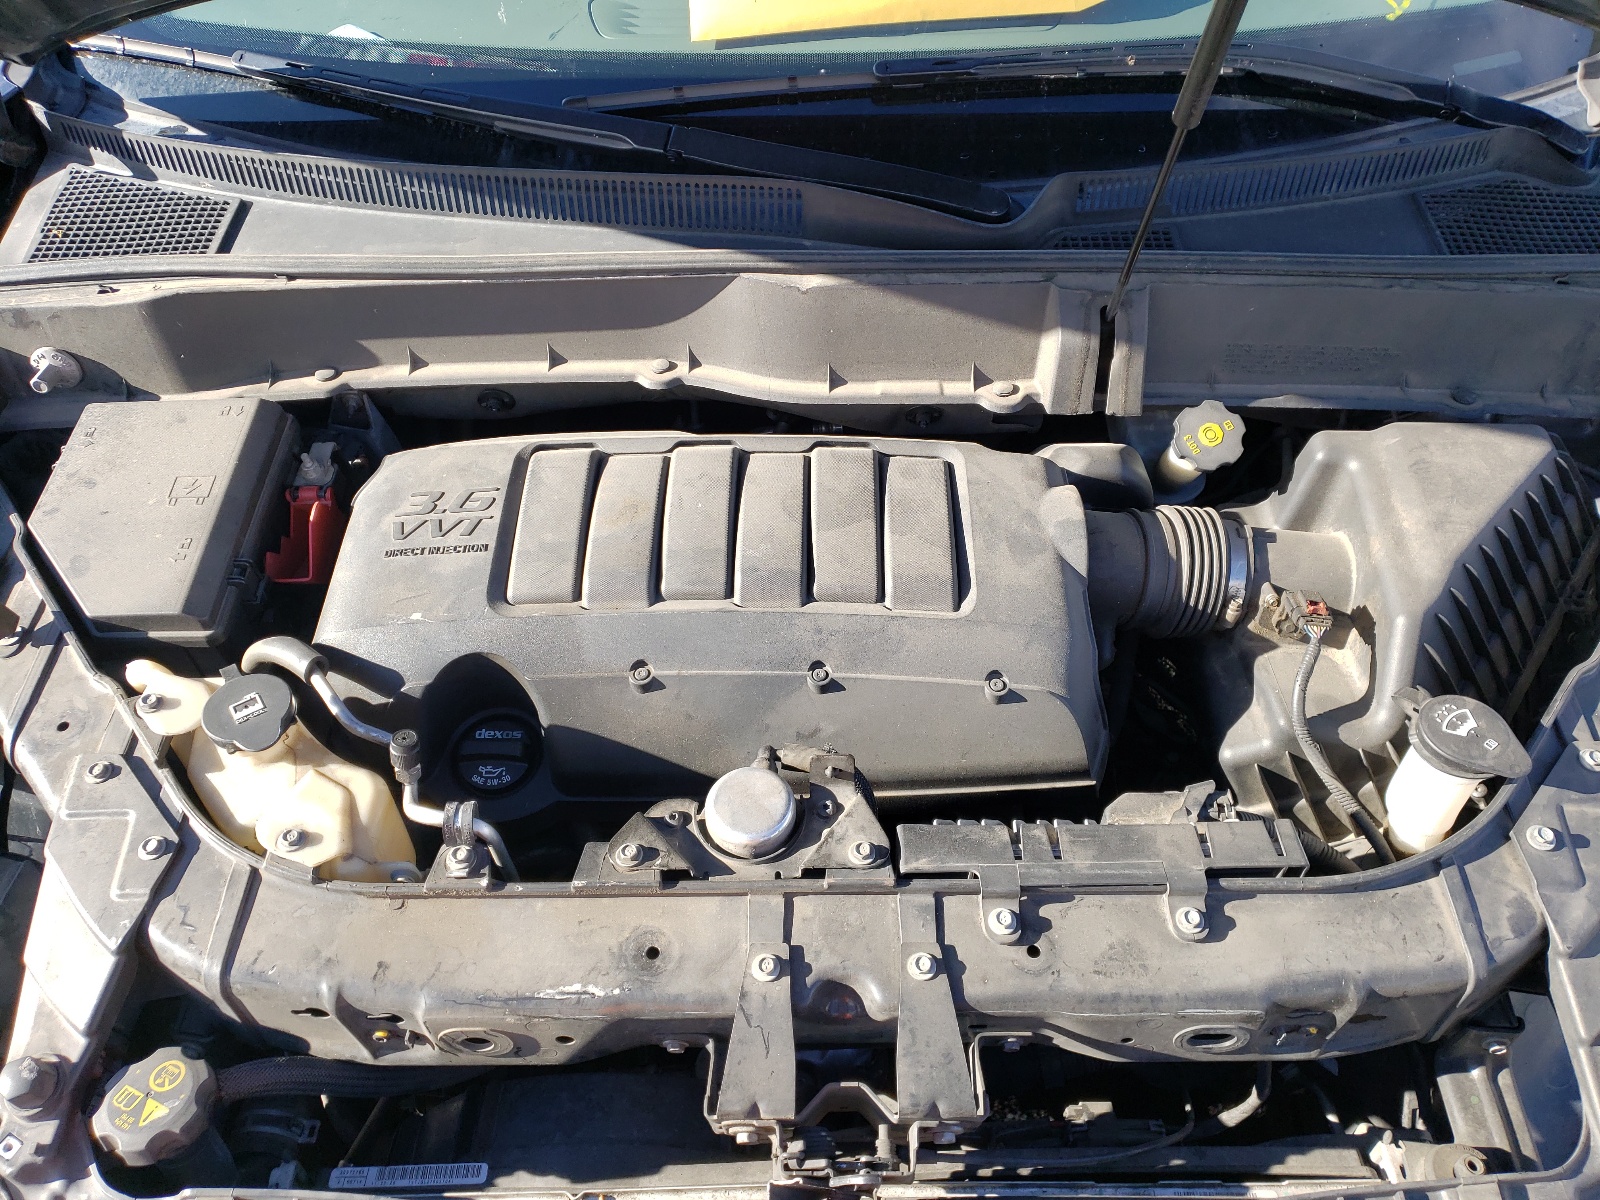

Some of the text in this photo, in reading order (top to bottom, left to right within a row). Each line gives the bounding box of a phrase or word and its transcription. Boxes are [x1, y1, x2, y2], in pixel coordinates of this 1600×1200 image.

[1183, 434, 1201, 454] DOT 3
[394, 486, 501, 517] 3.6
[392, 515, 495, 541] VVT
[384, 543, 489, 559] DIRECT INJECTION
[475, 728, 523, 739] dexos
[471, 774, 511, 786] SAE 5W-30
